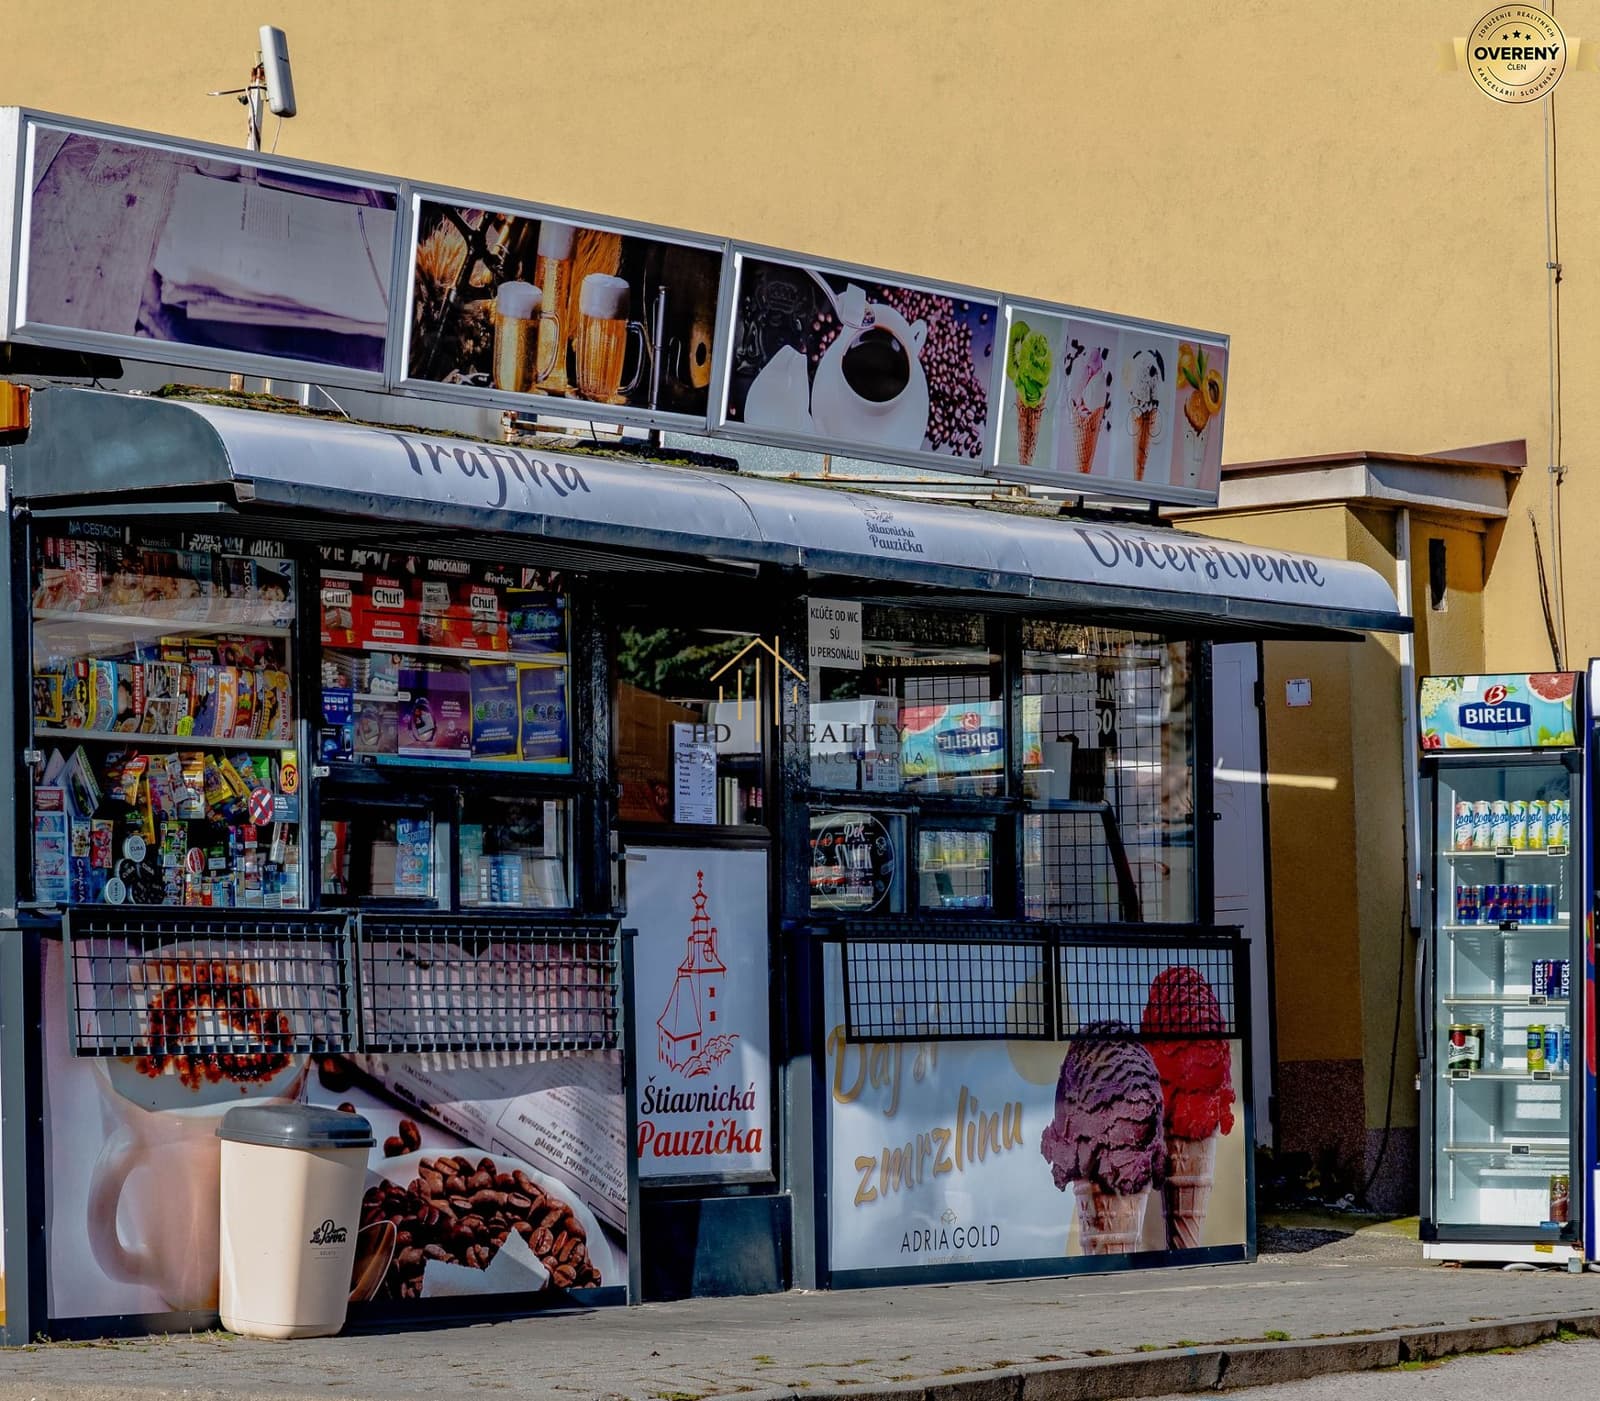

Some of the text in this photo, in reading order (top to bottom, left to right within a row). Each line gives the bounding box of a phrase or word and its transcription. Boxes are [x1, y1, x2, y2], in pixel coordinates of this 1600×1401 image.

[387, 432, 591, 508] Trafika
[869, 534, 924, 553] Pauzička
[834, 610, 846, 622] OD
[847, 611, 858, 623] WC
[829, 627, 840, 640] SÚ
[810, 645, 860, 662] U PERSONÁLU
[1464, 706, 1527, 725] BIRELL
[1535, 963, 1544, 995] TIGER
[1561, 963, 1570, 996] TIGER
[640, 1075, 756, 1115] Štiavnická
[636, 1116, 763, 1158] Pauzička
[853, 1084, 1024, 1207] zmrzlinu
